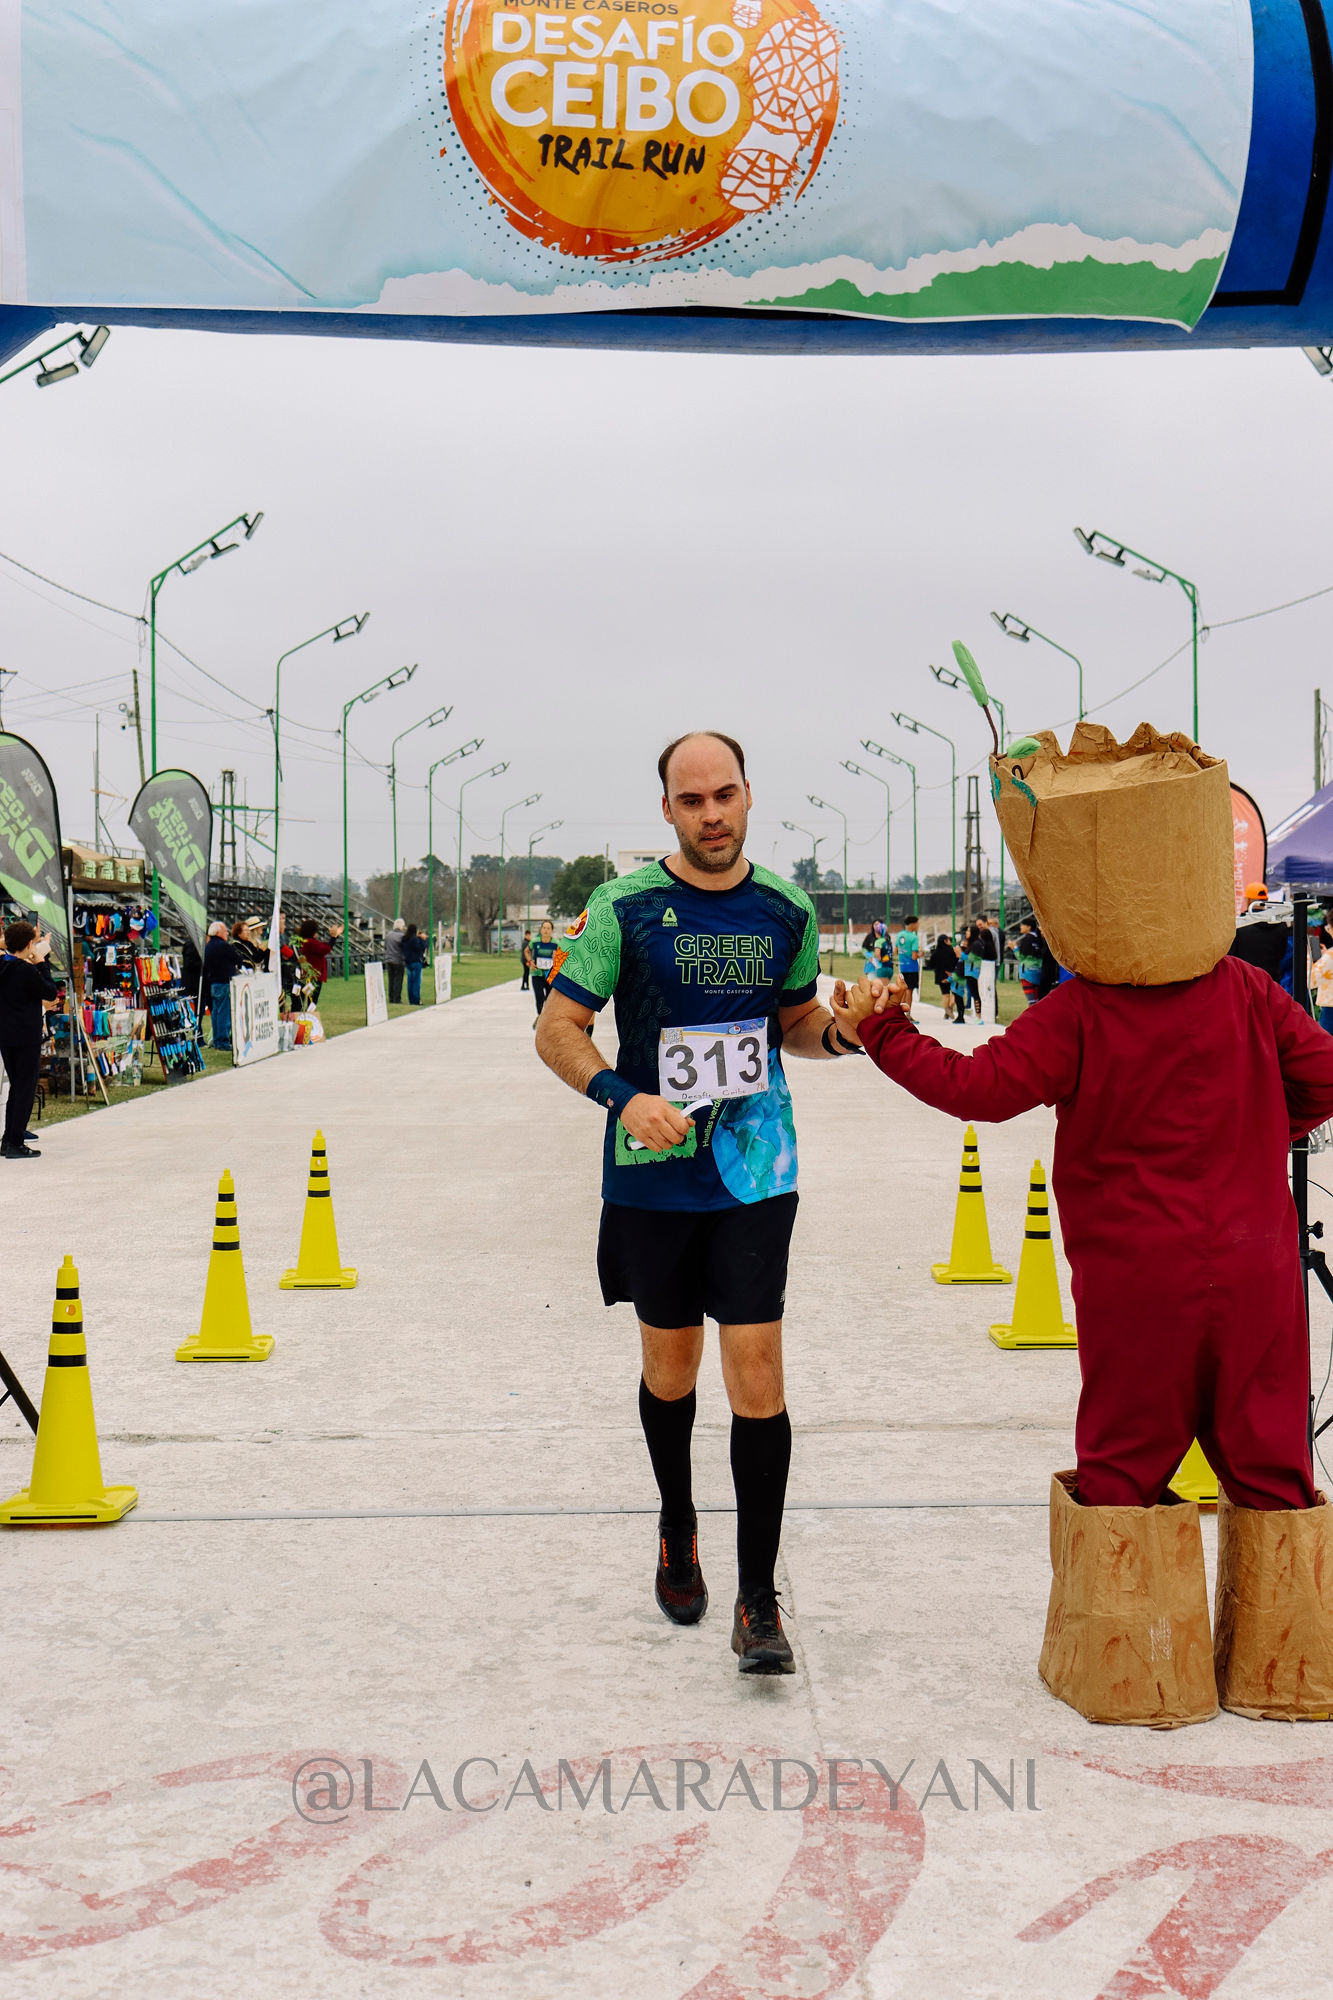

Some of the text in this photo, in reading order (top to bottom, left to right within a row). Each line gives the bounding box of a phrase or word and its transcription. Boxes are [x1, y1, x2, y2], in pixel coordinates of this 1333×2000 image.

[583, 0, 679, 15] CASEROS
[492, 12, 745, 67] DESAFÍO
[490, 59, 741, 138] CEIBO
[538, 133, 706, 181] TRAIL RUN
[674, 933, 773, 959] GREEN
[675, 957, 773, 986] TRAIL
[665, 1036, 762, 1091] 313
[702, 1120, 714, 1148] Huellas
